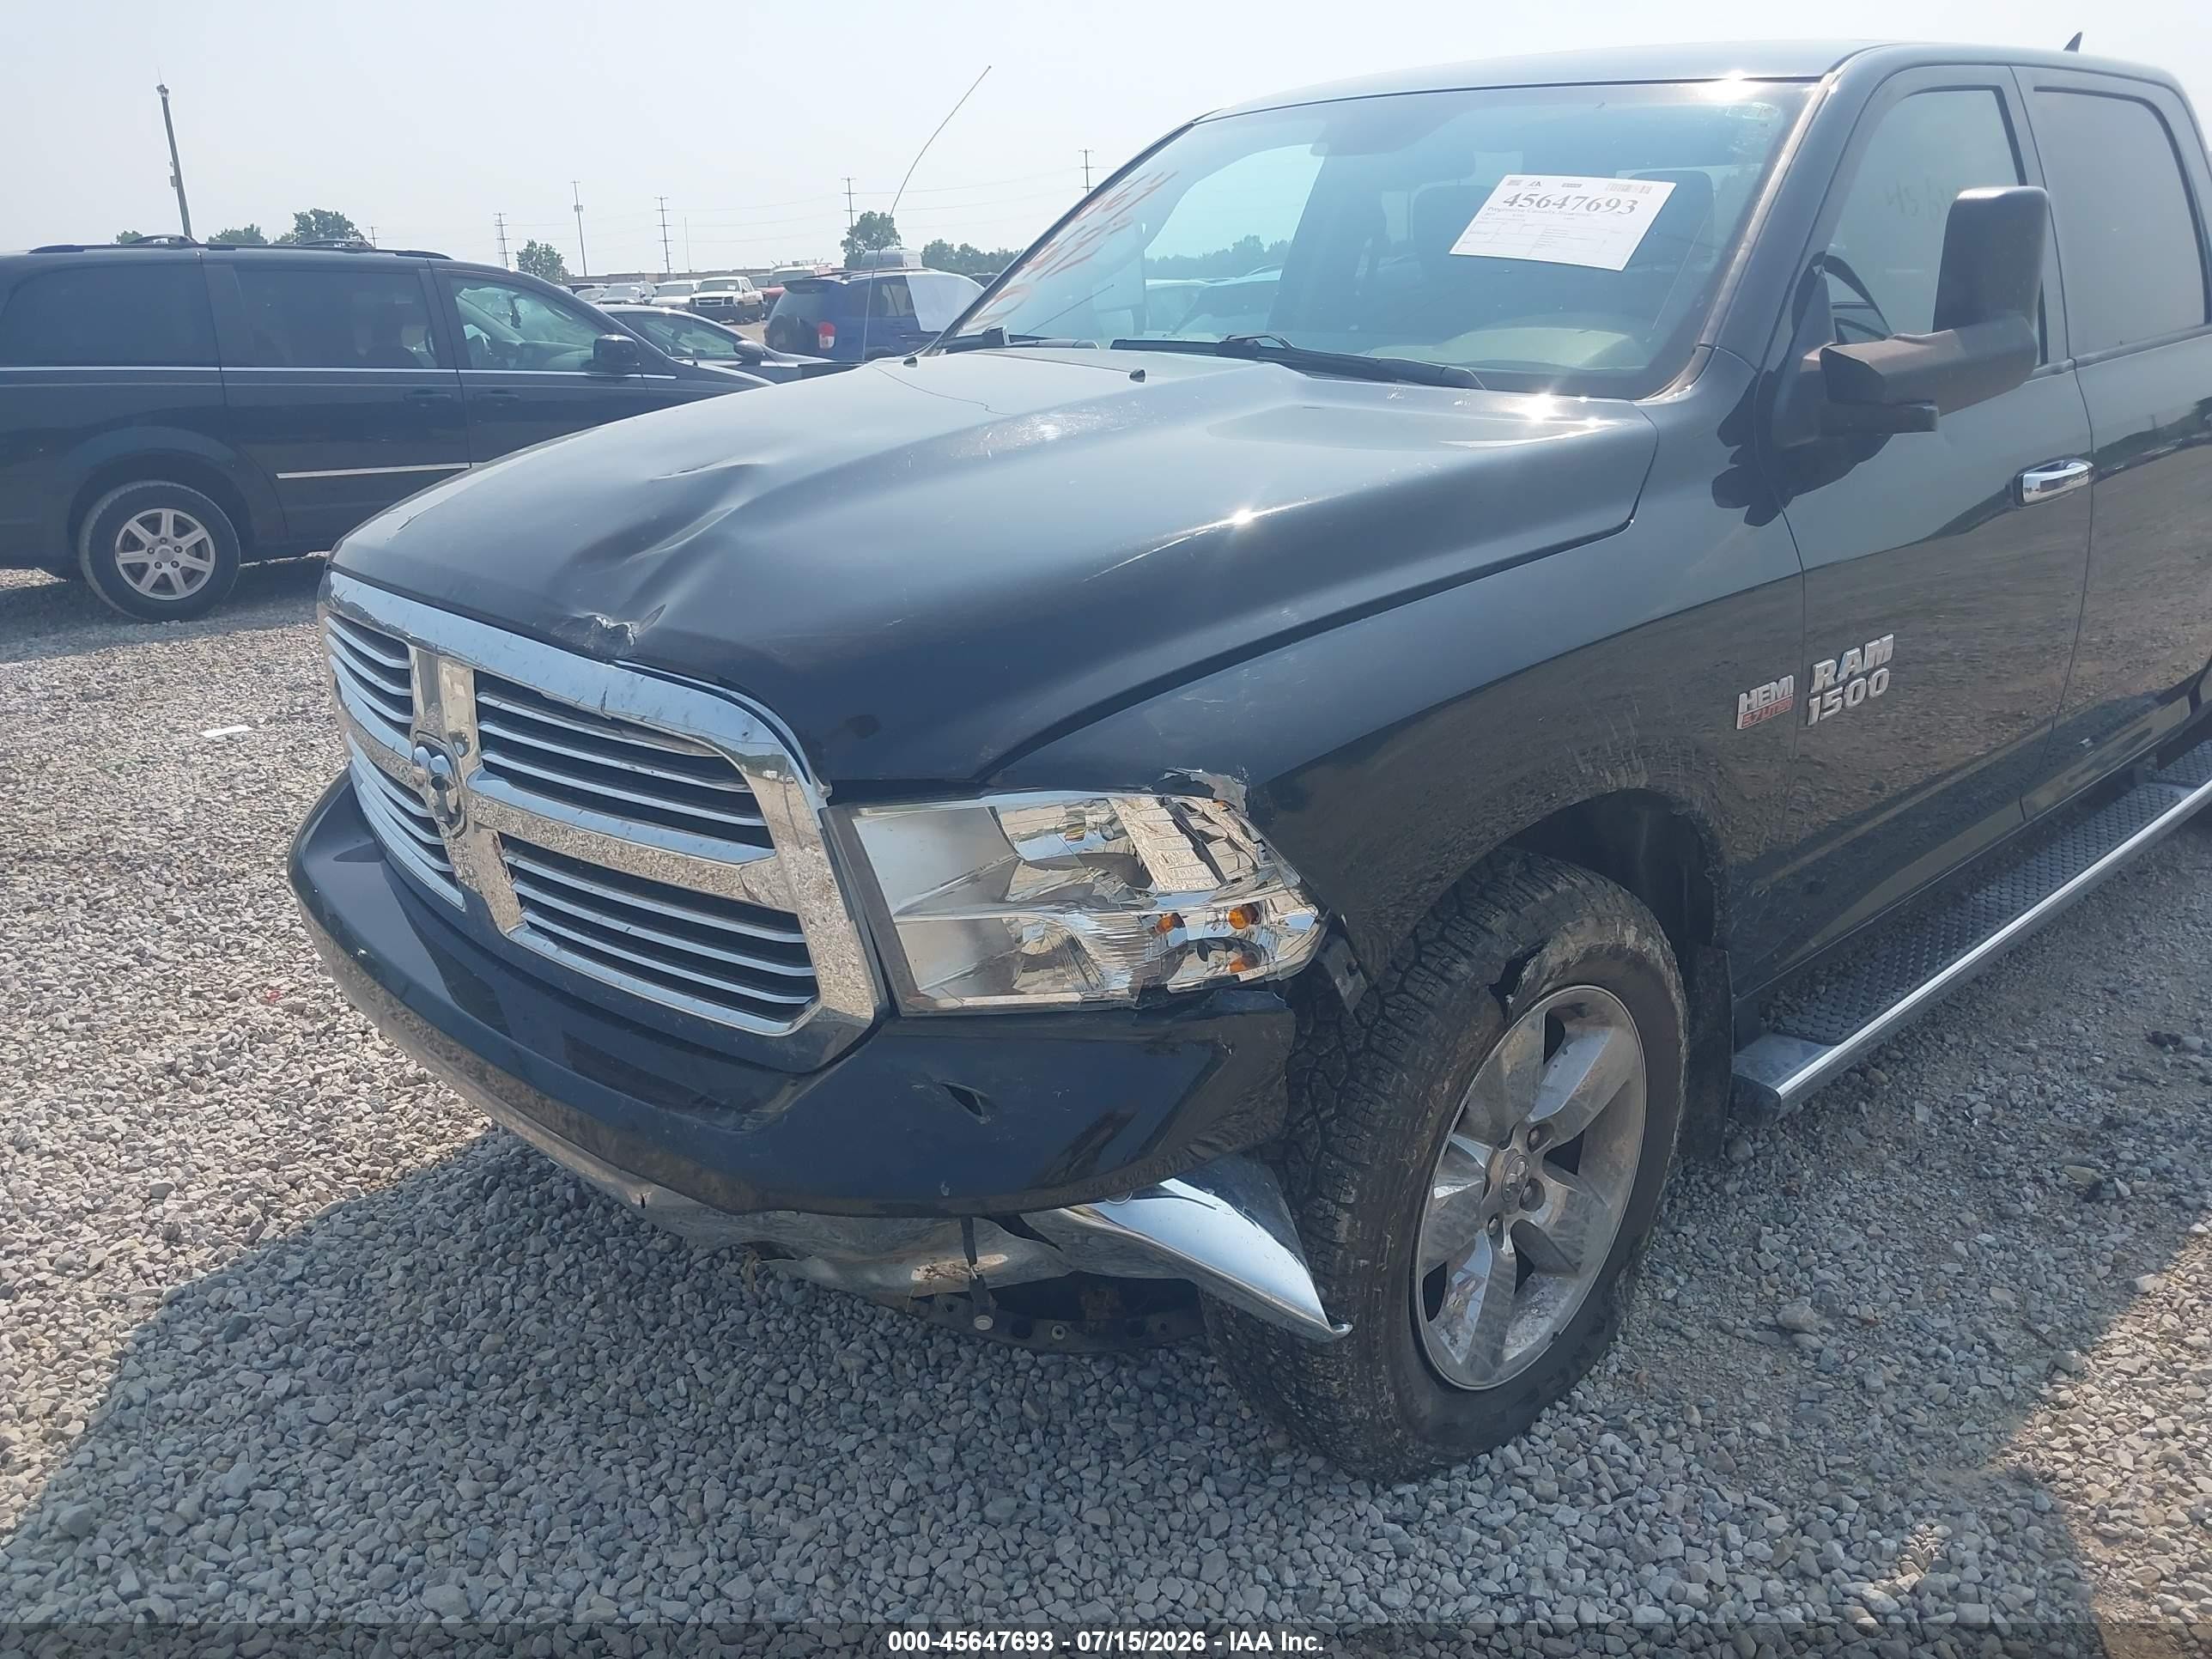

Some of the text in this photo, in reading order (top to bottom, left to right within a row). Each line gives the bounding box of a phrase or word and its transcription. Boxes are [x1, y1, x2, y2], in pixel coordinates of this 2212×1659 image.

[1504, 191, 1638, 216] 45647693
[1809, 633, 1894, 694] RAM
[1737, 675, 1795, 714] HEMI
[1808, 667, 1890, 726] 1500
